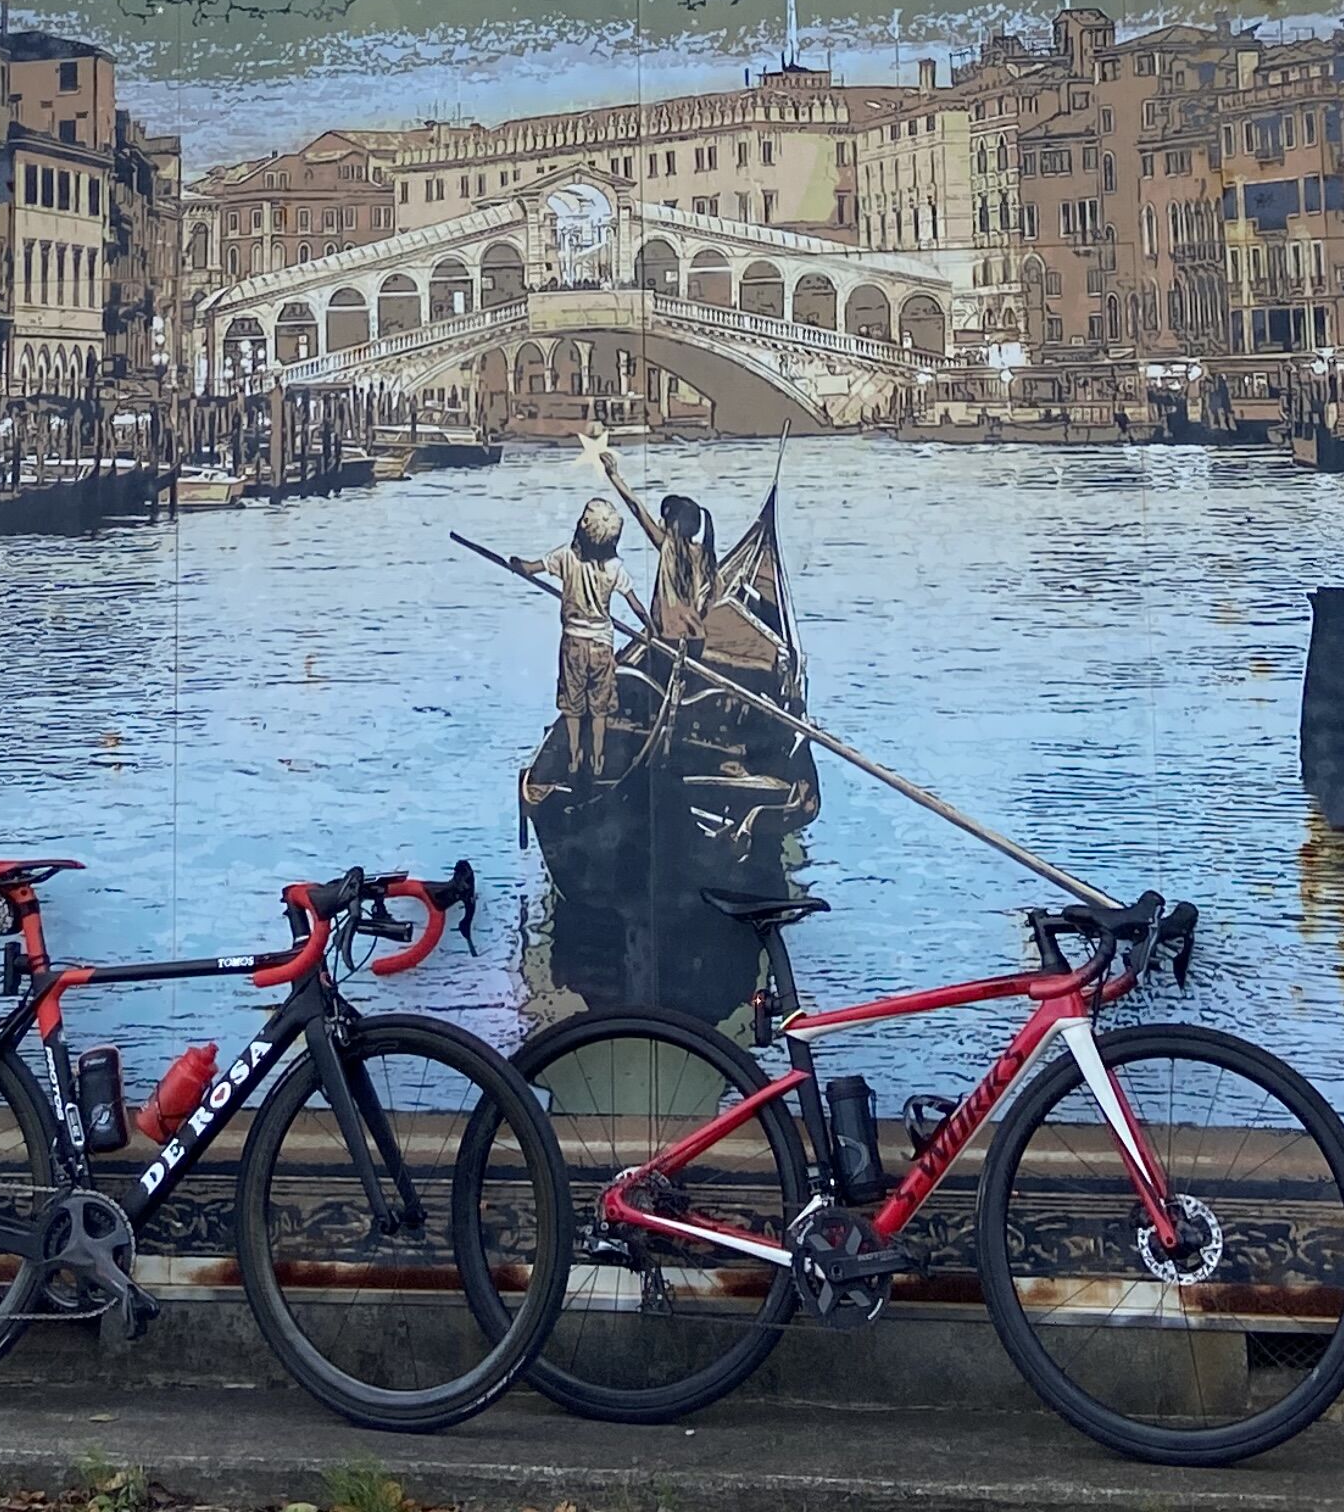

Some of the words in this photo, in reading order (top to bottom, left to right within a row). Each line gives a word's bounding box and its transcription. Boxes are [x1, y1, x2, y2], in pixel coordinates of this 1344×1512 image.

[45, 1046, 65, 1121] PROTOS
[140, 1138, 185, 1195] DE
[188, 1041, 273, 1136] ROSA
